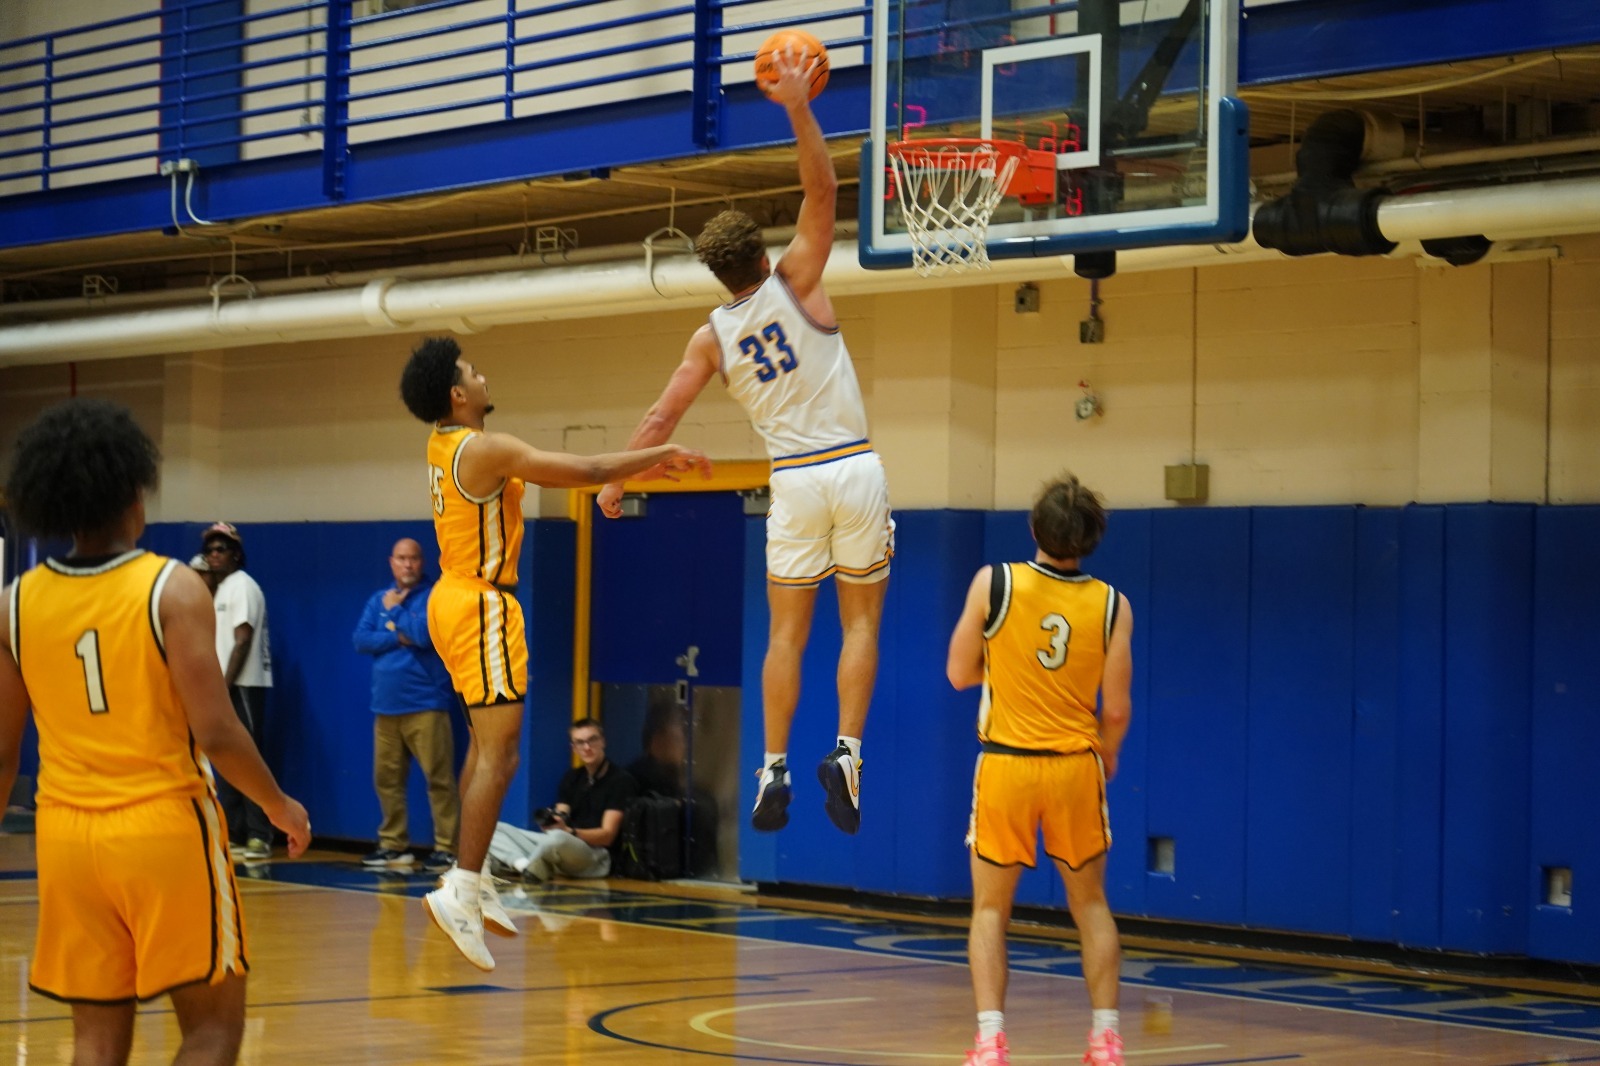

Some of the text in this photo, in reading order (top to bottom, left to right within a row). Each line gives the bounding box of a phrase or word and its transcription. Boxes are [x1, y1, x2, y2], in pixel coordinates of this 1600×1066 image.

[738, 320, 799, 383] 33
[75, 628, 109, 714] 1
[1036, 611, 1072, 671] 3
